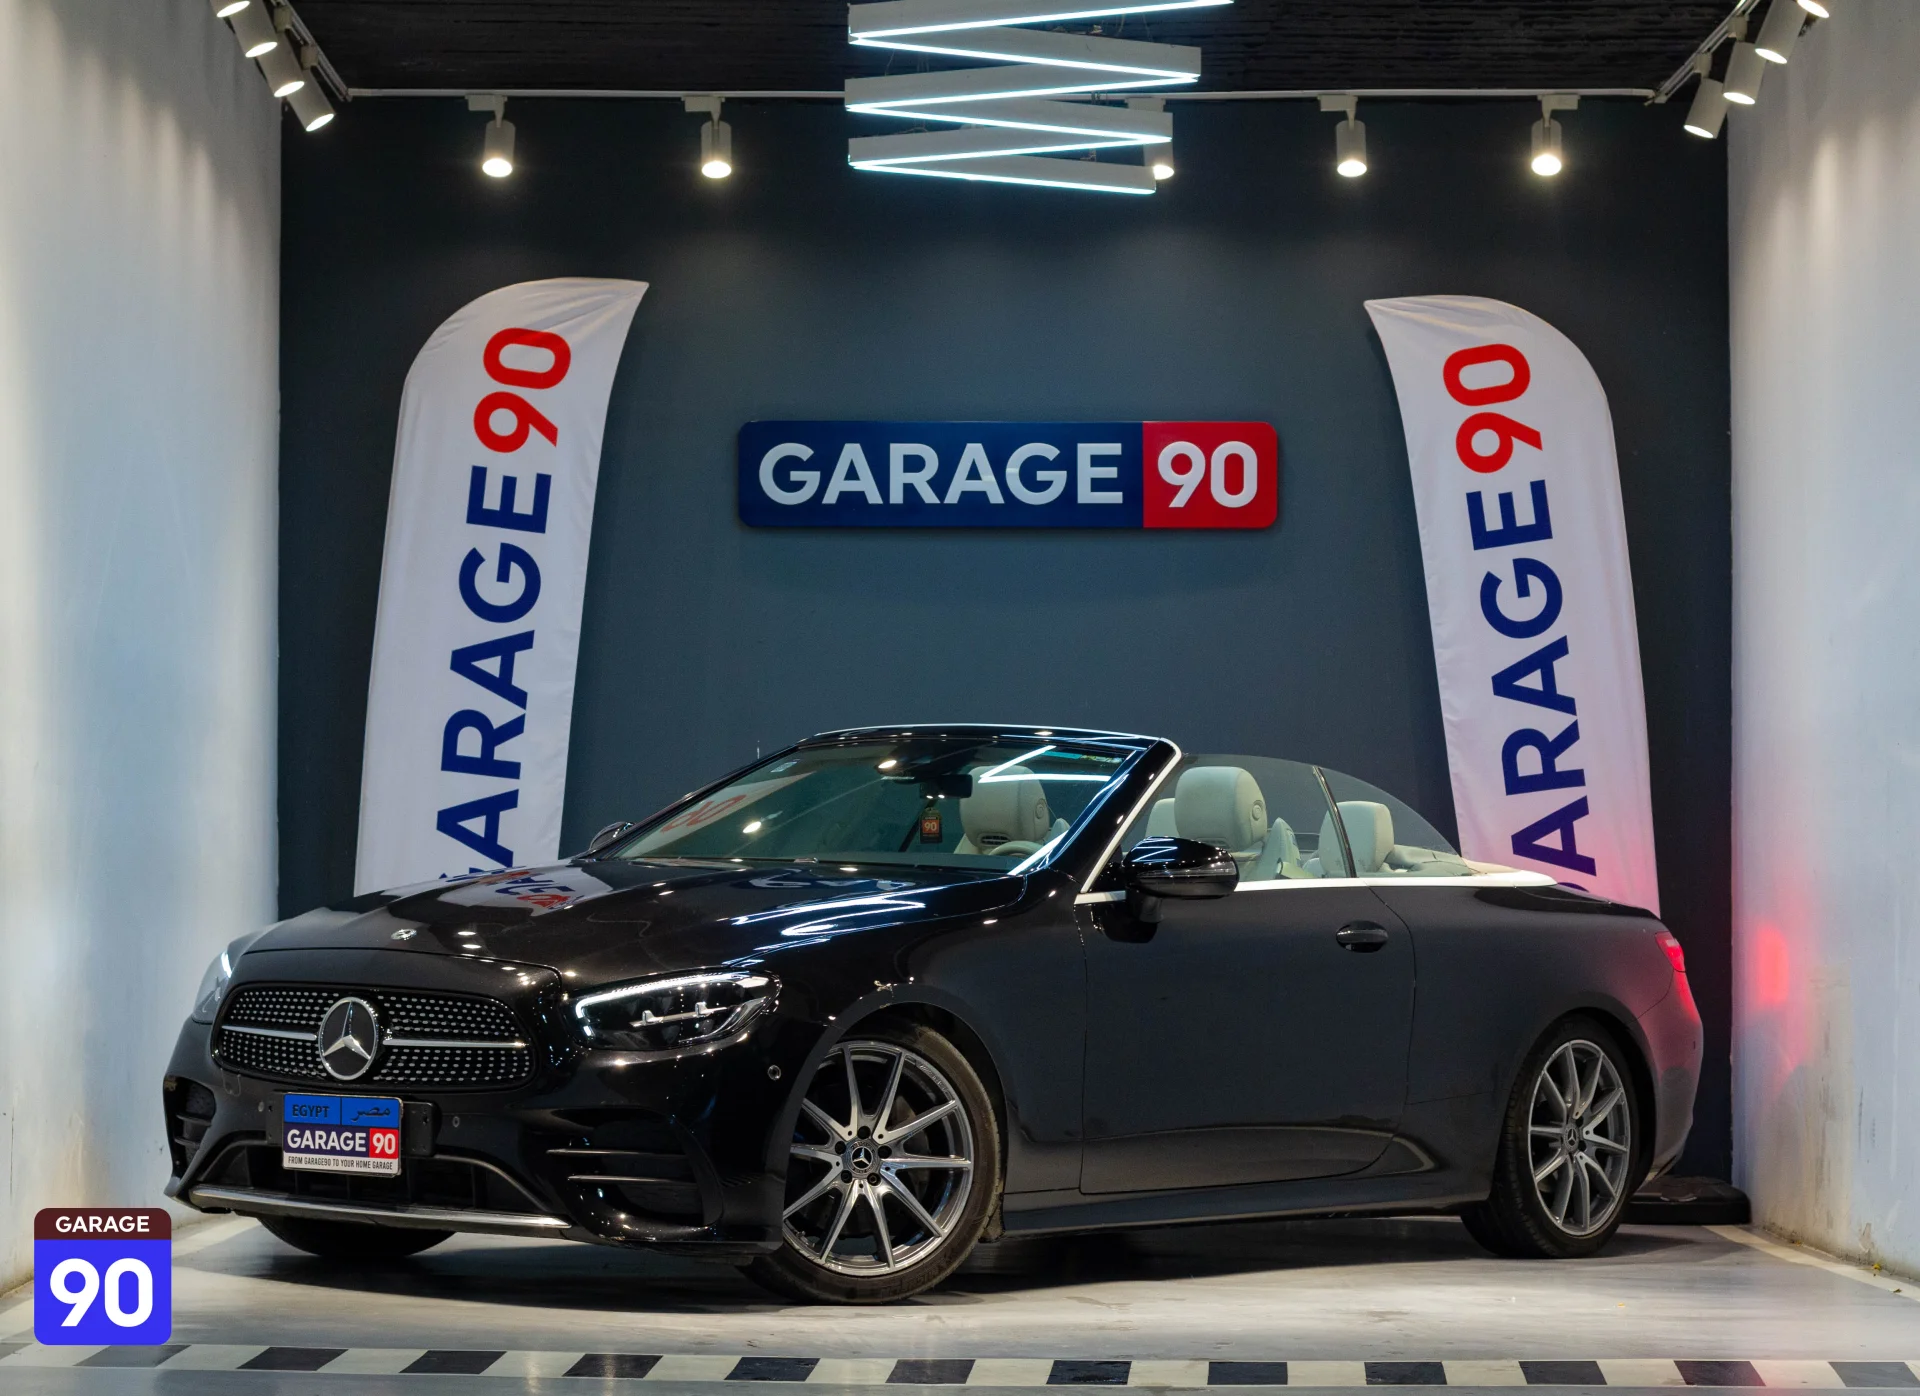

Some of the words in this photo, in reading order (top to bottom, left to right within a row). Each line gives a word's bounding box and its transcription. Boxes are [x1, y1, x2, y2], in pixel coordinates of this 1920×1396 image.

[758, 442, 1123, 506] GARAGE
[1157, 440, 1259, 509] 90
[436, 327, 572, 878] ARAGE90
[1443, 343, 1598, 892] ARAGE90
[924, 821, 937, 831] 90
[292, 1104, 329, 1118] EGYPT
[351, 1105, 391, 1122] مصر
[287, 1129, 366, 1151] GARAGE
[372, 1133, 396, 1155] 90
[288, 1156, 303, 1165] FROM
[304, 1157, 331, 1167] GARAGE90
[333, 1159, 340, 1167] TO
[341, 1159, 355, 1169] YOUR
[355, 1160, 371, 1170] HOME
[372, 1161, 393, 1171] GARAGE
